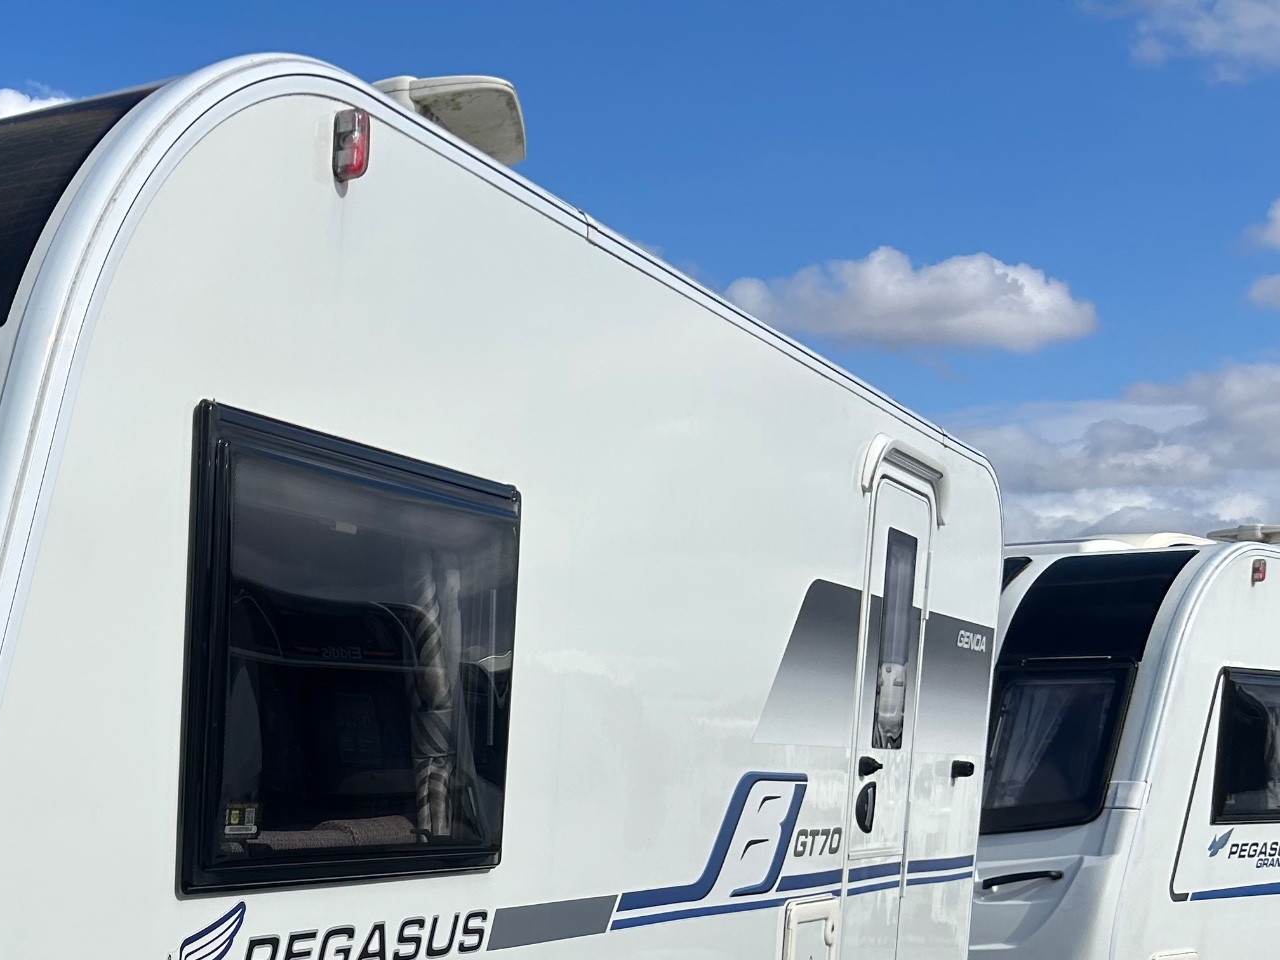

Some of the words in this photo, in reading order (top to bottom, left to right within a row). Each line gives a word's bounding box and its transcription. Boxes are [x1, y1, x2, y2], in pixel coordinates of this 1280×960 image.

[957, 629, 986, 653] GENOA
[793, 827, 842, 858] GT70
[1227, 841, 1280, 860] PEGAS
